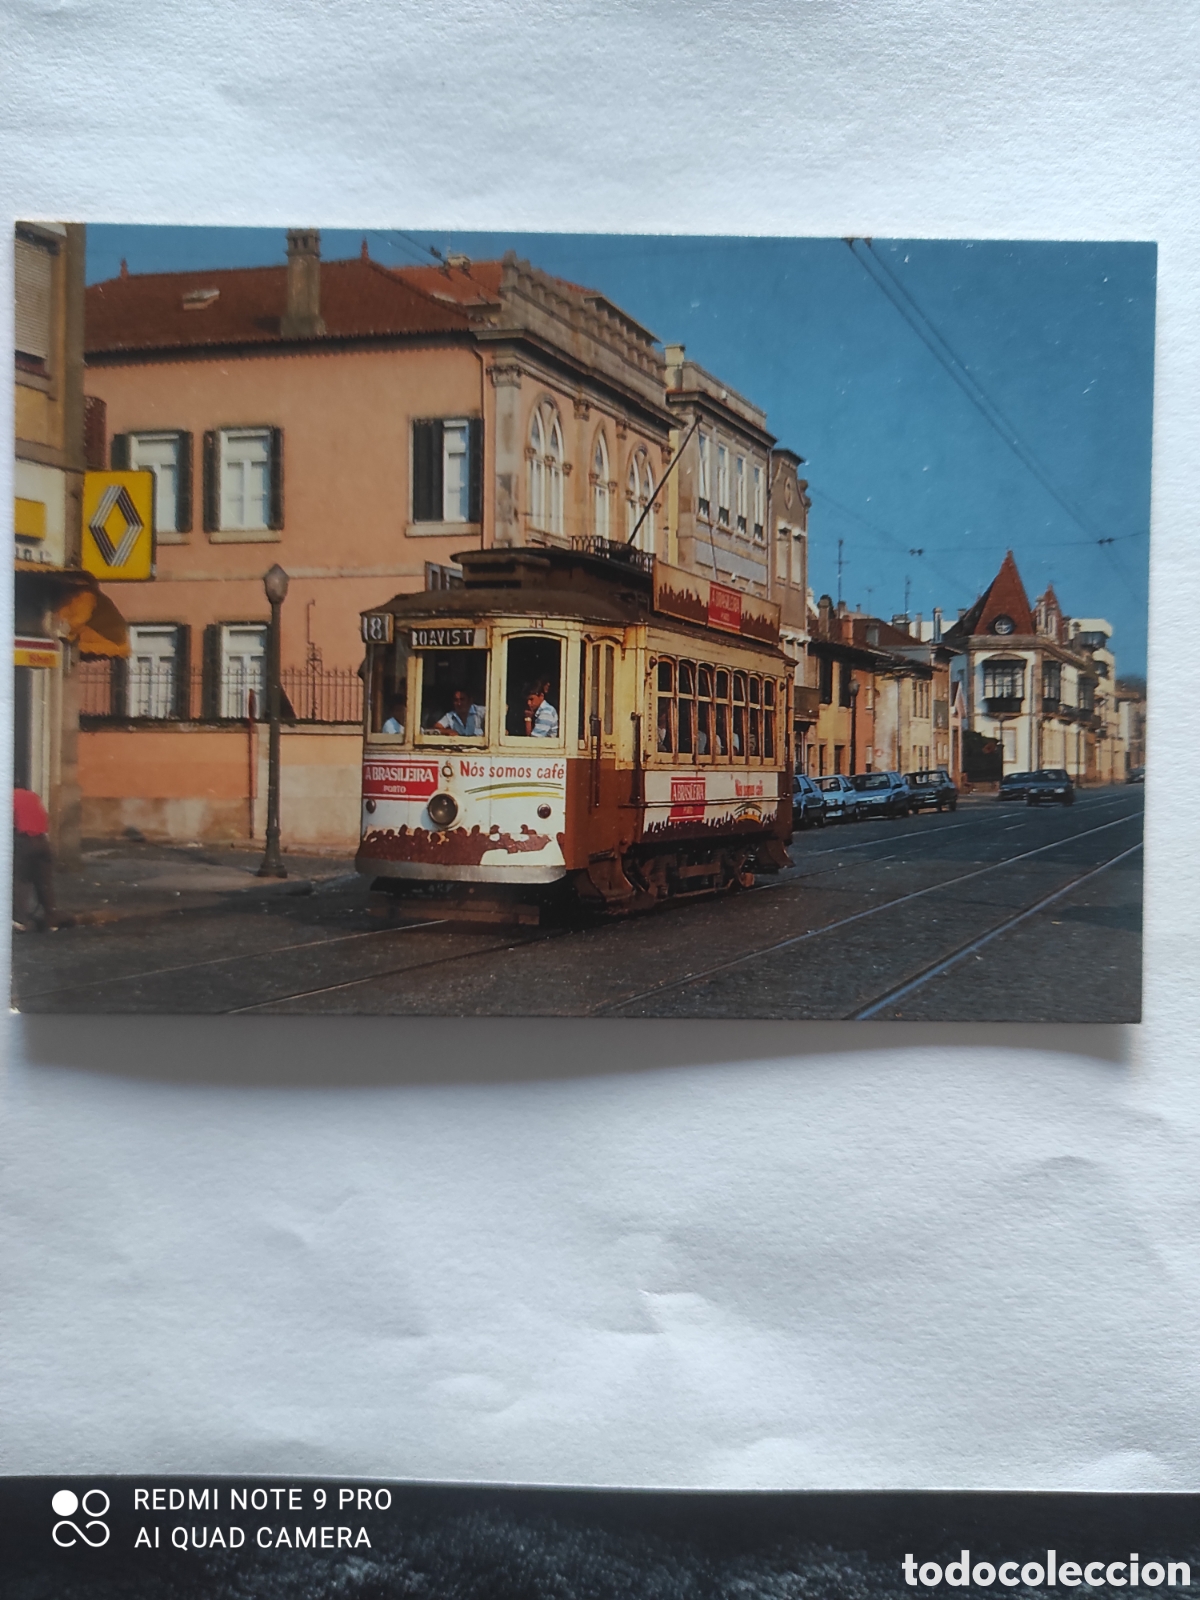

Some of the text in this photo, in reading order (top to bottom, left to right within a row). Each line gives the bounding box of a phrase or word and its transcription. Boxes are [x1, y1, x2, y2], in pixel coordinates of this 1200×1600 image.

[372, 767, 435, 783] BRASILEIRA
[460, 760, 565, 780] Nós somos café
